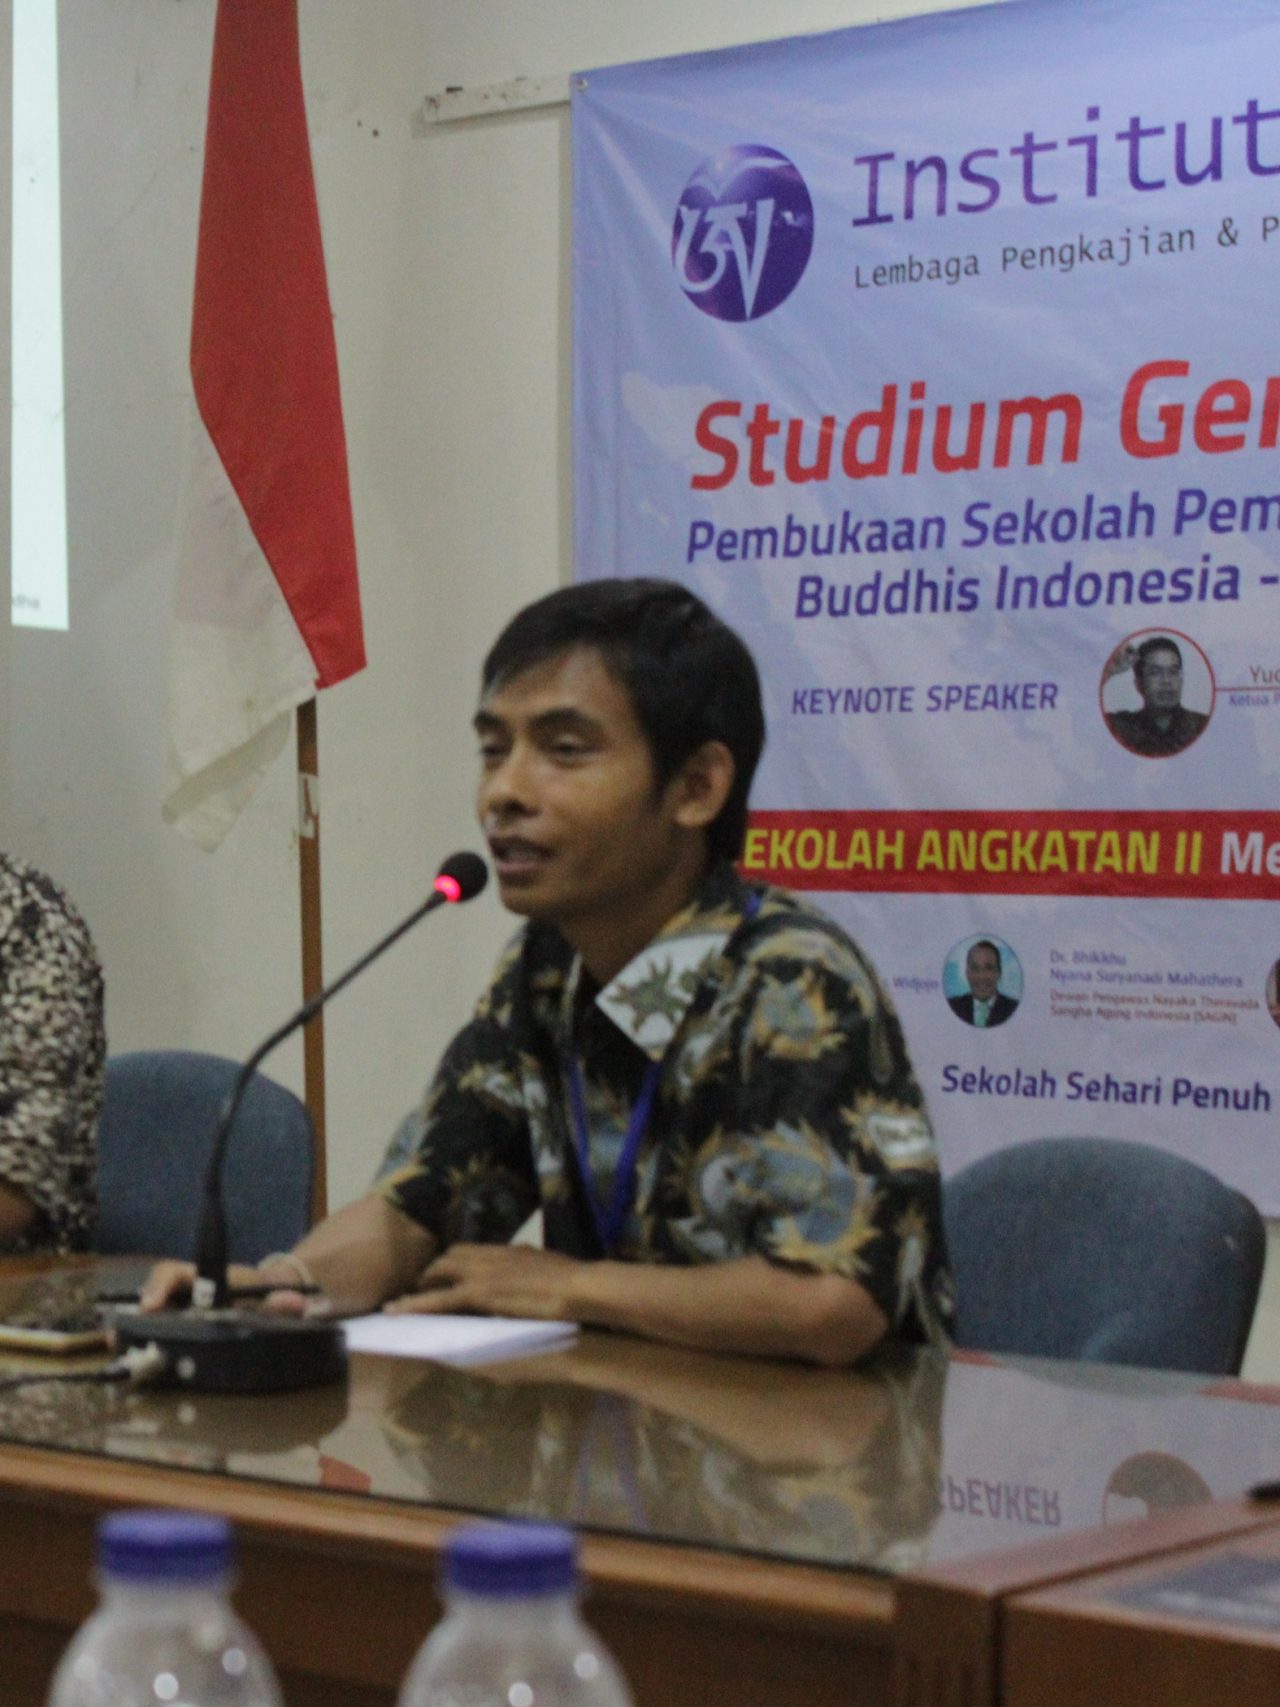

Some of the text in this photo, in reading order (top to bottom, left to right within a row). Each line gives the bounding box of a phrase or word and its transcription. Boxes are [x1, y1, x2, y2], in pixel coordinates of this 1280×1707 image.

[851, 98, 1280, 229] Institut
[854, 248, 981, 289] Lembaga
[1001, 224, 1196, 274] Pengkajian
[1217, 216, 1239, 247] &
[690, 380, 1083, 491] Studium
[687, 511, 947, 563] Pembukaan
[961, 490, 1156, 548] Sekolah
[795, 567, 980, 619] Buddhis
[995, 554, 1241, 611] Indonesia
[792, 682, 1059, 715] KEYNOTE SPEAKER
[916, 829, 1159, 874] ANGKATAN
[1174, 831, 1202, 875] II
[941, 1064, 1272, 1112] Sekolah Sehari Penuh
